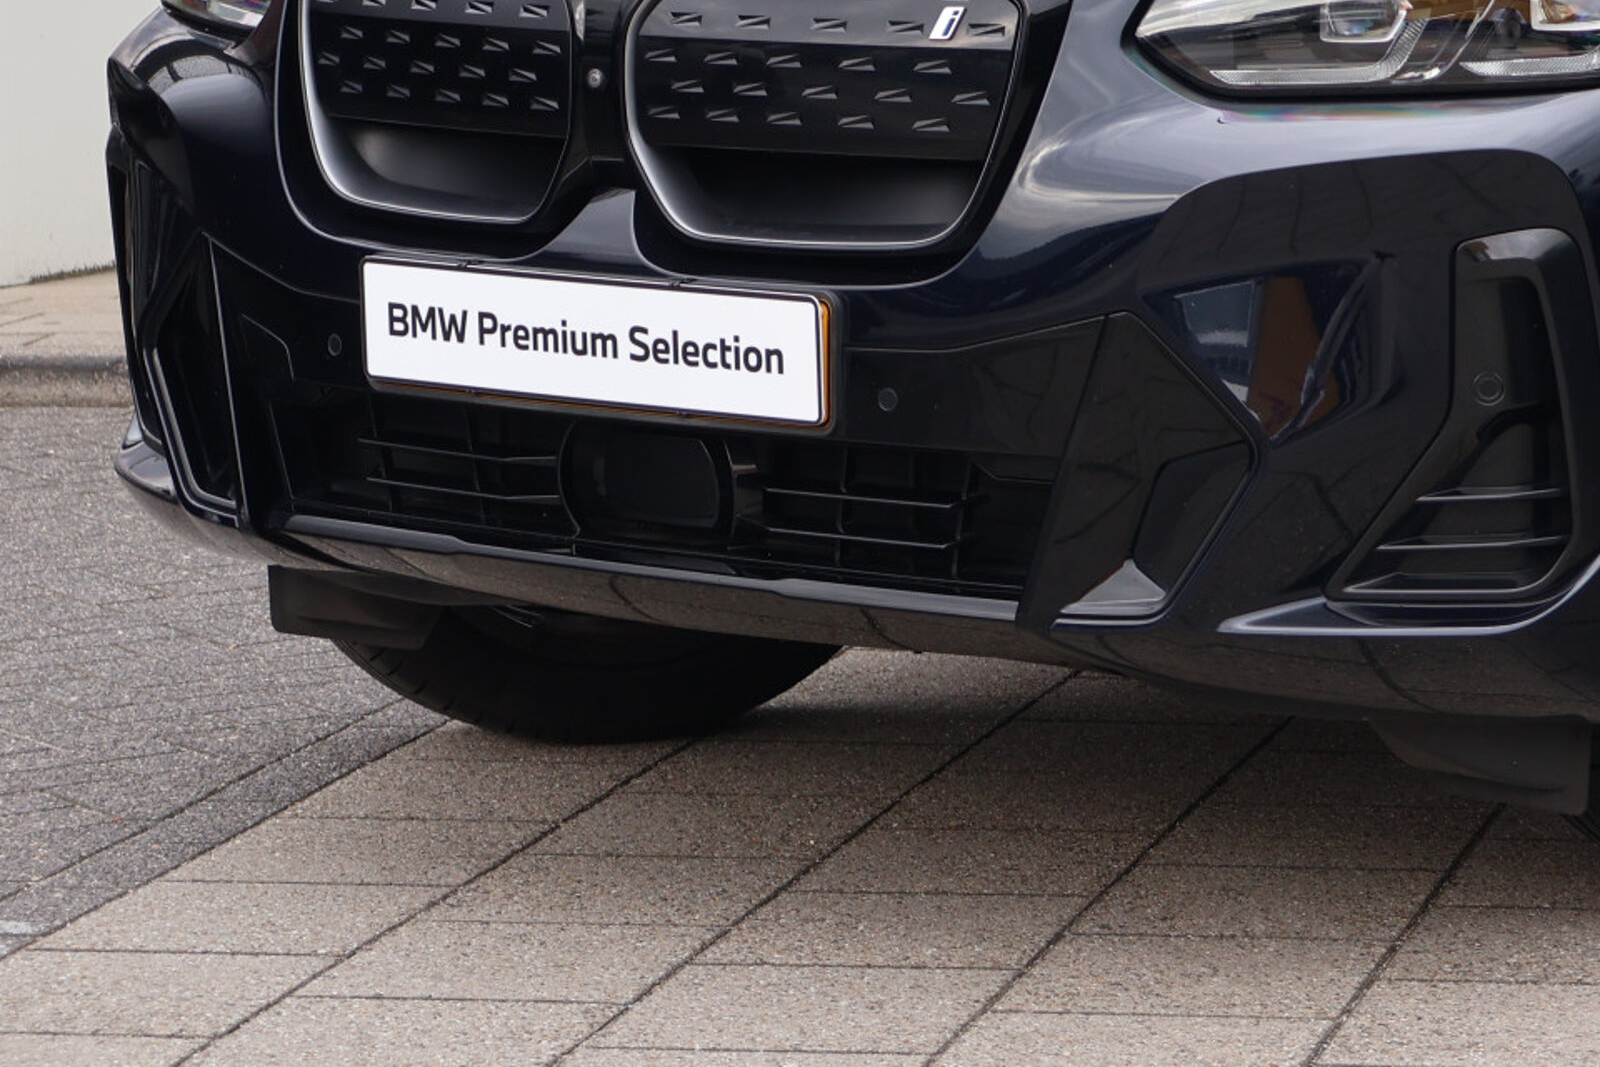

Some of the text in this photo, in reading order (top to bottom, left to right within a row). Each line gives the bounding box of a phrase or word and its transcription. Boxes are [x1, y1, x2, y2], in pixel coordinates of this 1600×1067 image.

[387, 302, 785, 375] BMW Premium Selection
